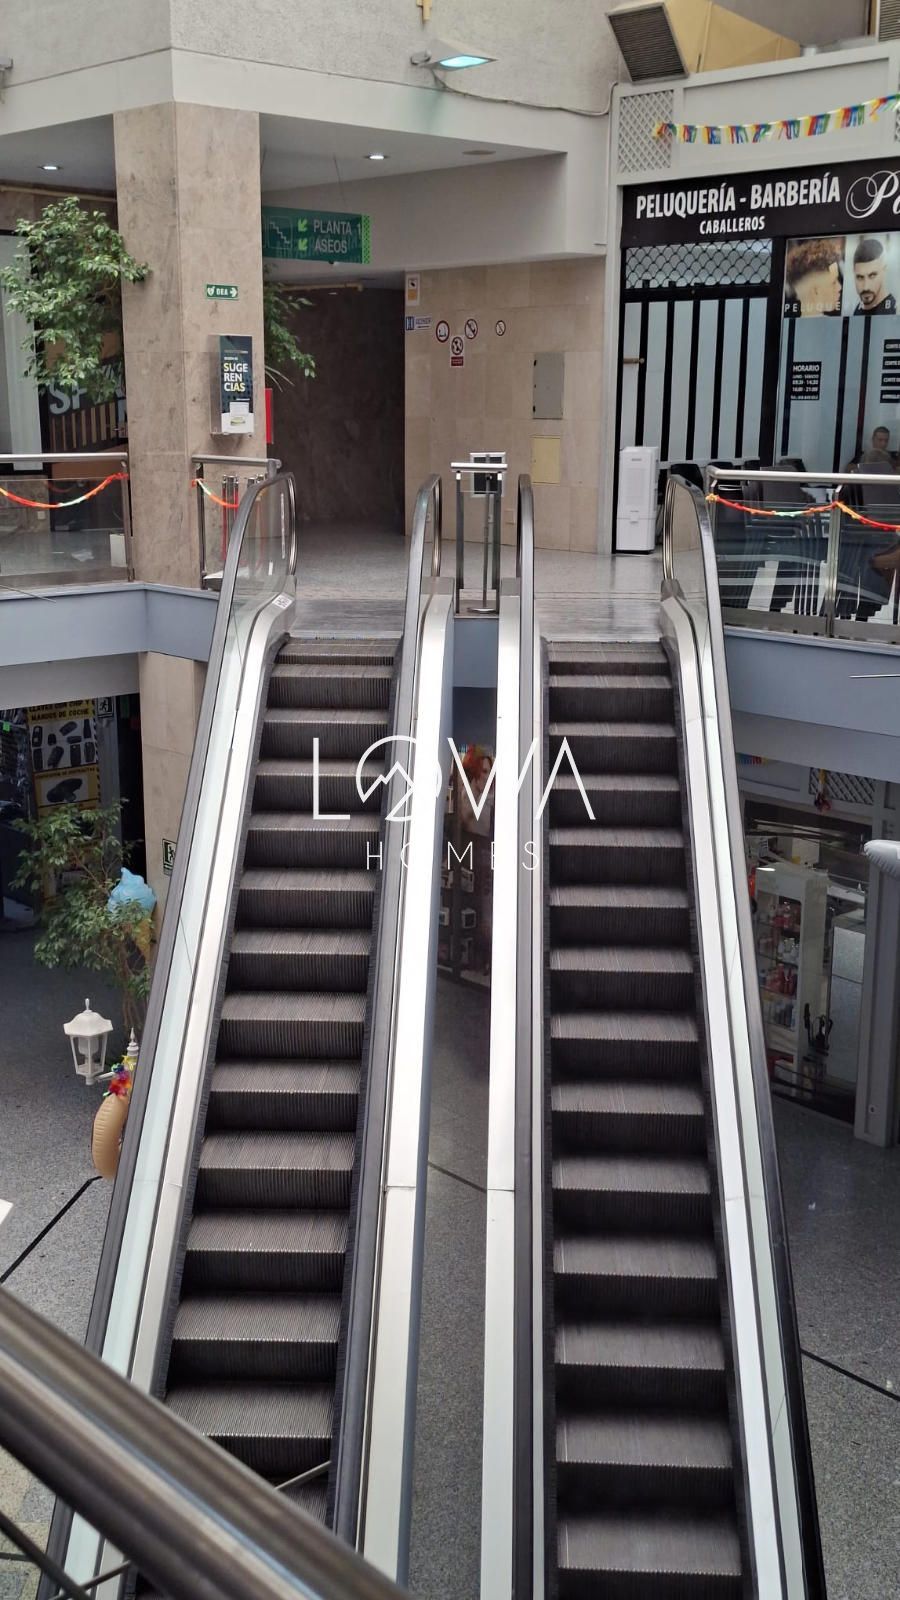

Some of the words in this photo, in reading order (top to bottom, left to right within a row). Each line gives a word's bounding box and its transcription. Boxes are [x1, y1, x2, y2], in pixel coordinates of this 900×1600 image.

[636, 183, 736, 219] PELUQUERÍA
[750, 172, 840, 209] BARBERÍA
[313, 219, 352, 236] PLANTA
[699, 216, 766, 235] CABALLEROS
[315, 239, 348, 254] ASEOS
[216, 288, 228, 296] DEA
[223, 362, 248, 373] SUGE
[223, 372, 242, 382] REN
[223, 382, 246, 392] CIAS
[59, 710, 67, 718] DE
[69, 708, 90, 717] COCHE
